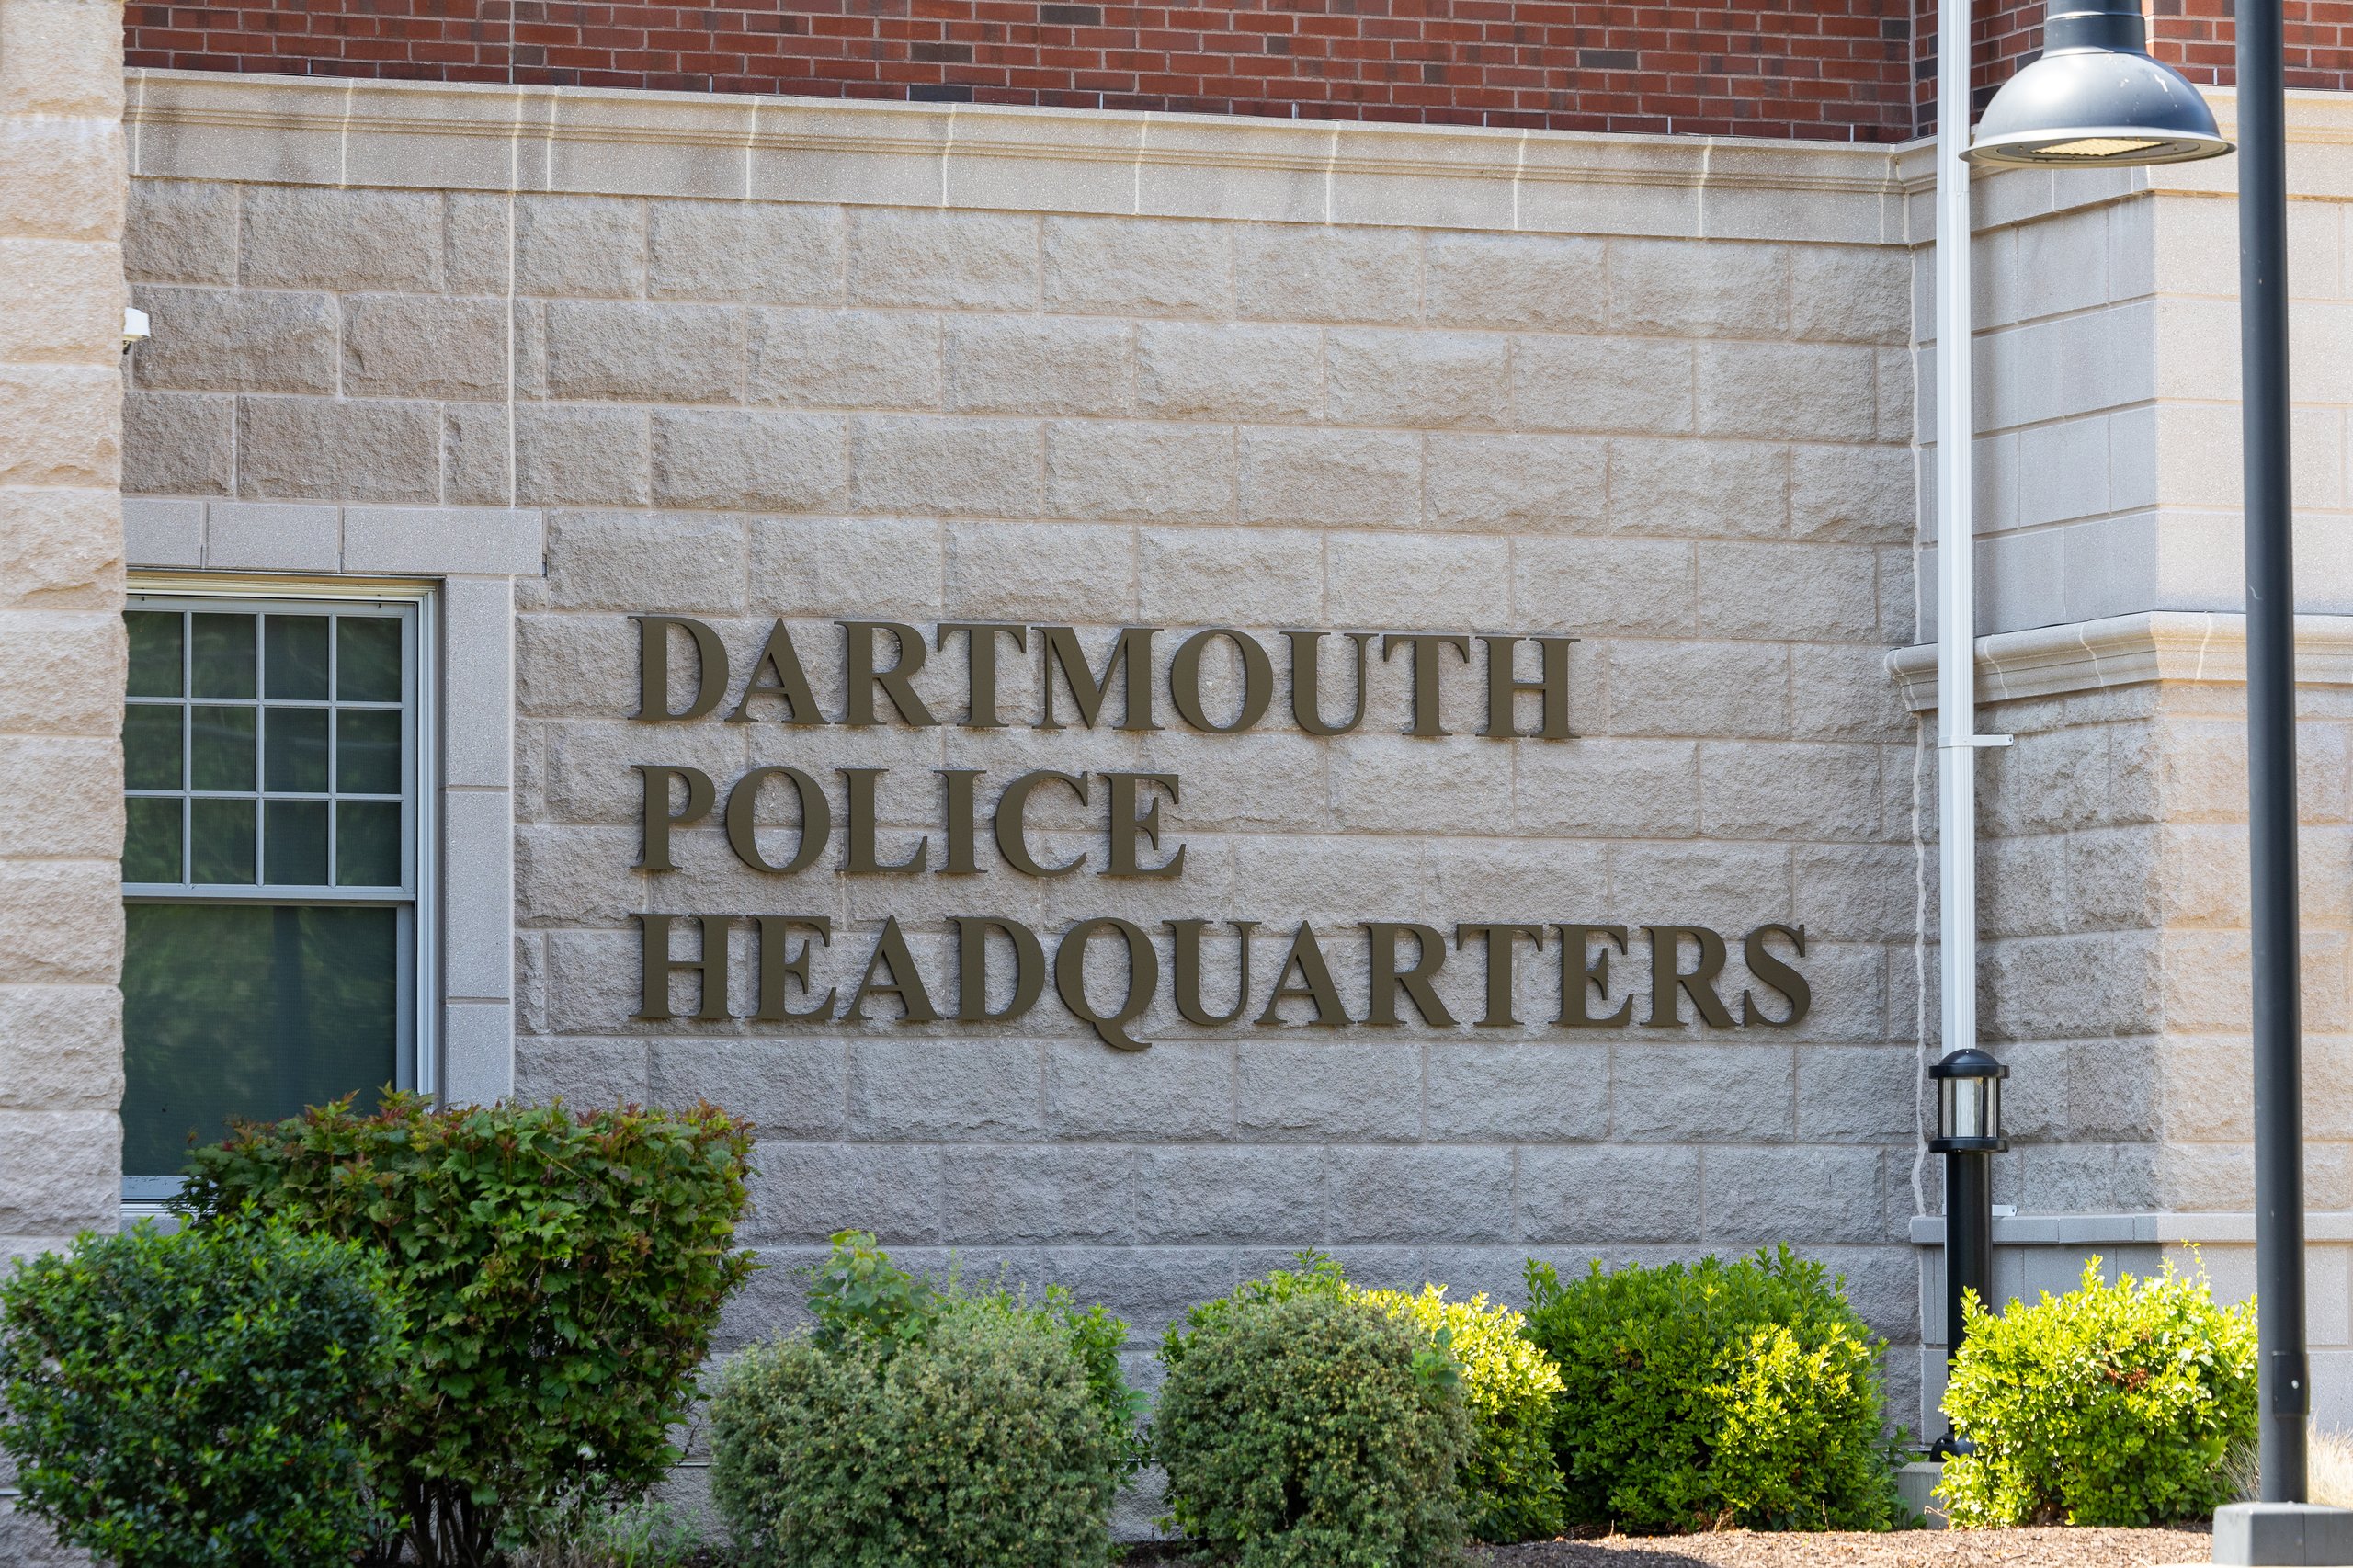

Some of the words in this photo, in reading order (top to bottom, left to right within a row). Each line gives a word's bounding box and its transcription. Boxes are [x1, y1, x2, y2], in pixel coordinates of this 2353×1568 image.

[627, 616, 1581, 739] DARTMOUTH
[630, 765, 1186, 877] POLICE
[628, 913, 1811, 1051] HEADQUARTERS
